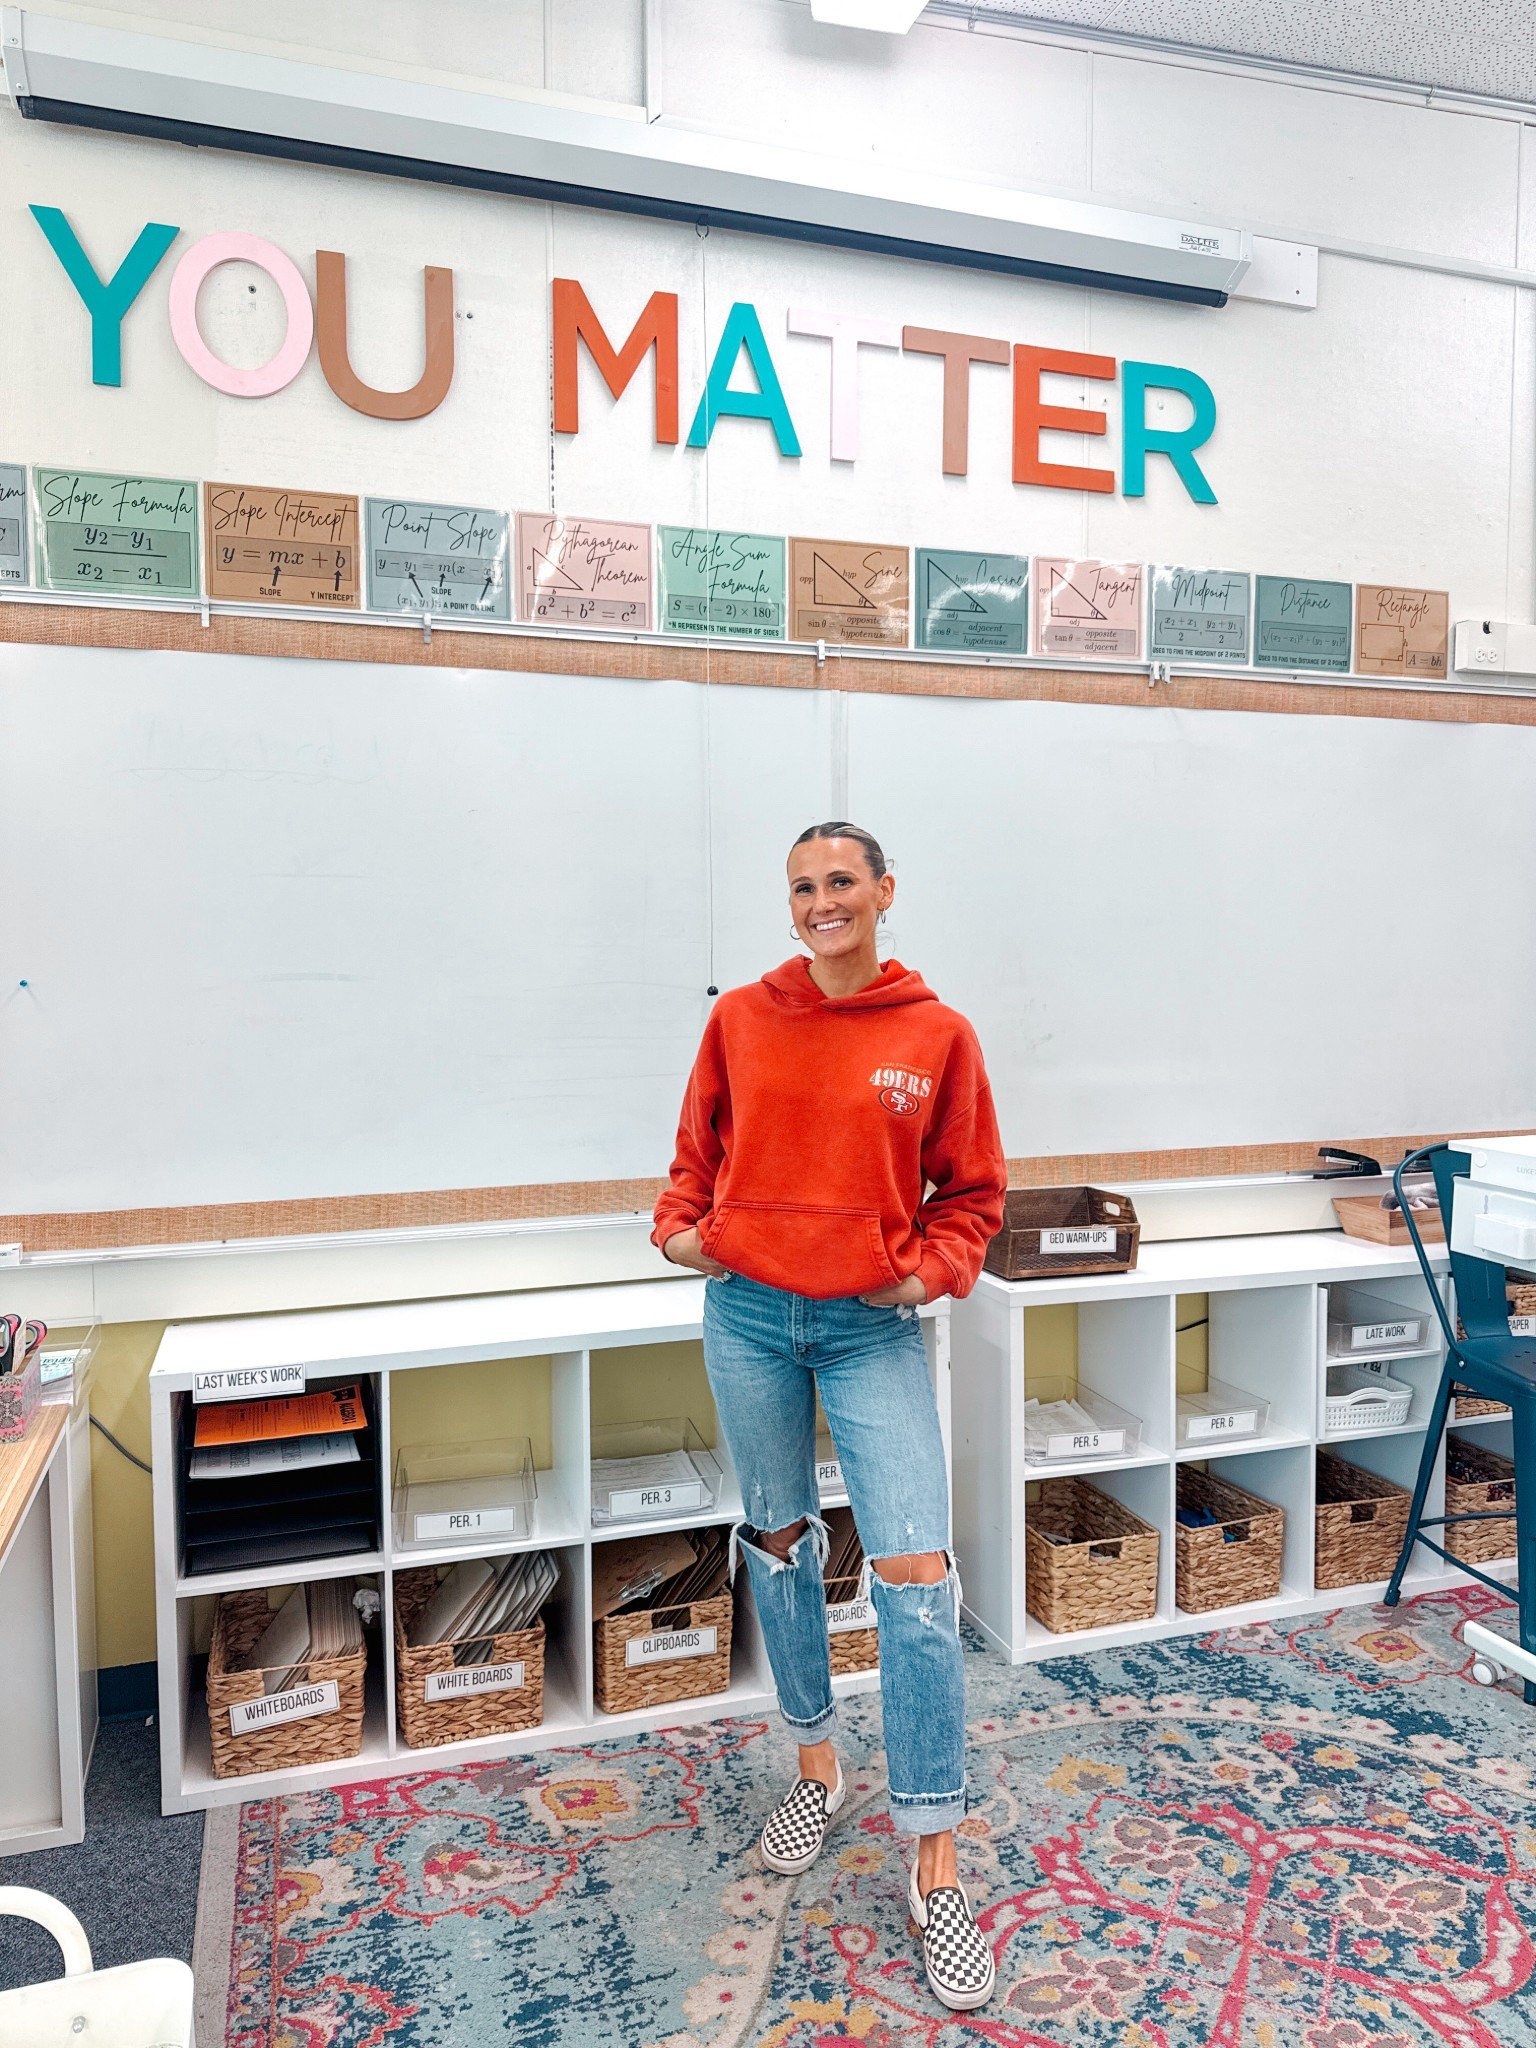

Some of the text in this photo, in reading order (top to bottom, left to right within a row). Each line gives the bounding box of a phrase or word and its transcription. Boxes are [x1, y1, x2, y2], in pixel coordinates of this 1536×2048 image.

[28, 204, 1219, 504] YOU MATTER
[44, 475, 193, 524] Slope Formula
[212, 490, 357, 542] Slope Intercept
[382, 504, 497, 555] Point Slope
[543, 520, 638, 564] Pythagorean
[672, 529, 770, 573] Angle Sum
[588, 553, 648, 592] Theorem
[842, 569, 857, 579] hyp
[863, 551, 902, 588] Sine
[976, 559, 1023, 594] Cosine
[431, 586, 452, 596] SLOPE
[707, 564, 769, 601] Formula
[1089, 565, 1141, 608] Tangent
[259, 587, 281, 597] SLOPE
[310, 591, 354, 602] Y INTERCEPT
[1172, 575, 1241, 611] Midpoint
[1281, 583, 1331, 618] Distance
[450, 602, 468, 610] POINT
[481, 605, 495, 613] LINE
[947, 612, 958, 620] adj
[1376, 588, 1430, 628] Rectangle
[678, 622, 715, 632] REPRESENTS
[716, 625, 727, 633] THE
[729, 626, 754, 635] NUMBER
[763, 629, 779, 637] SIDES
[968, 624, 1004, 633] adjacent
[1086, 630, 1117, 638] opposite
[963, 636, 1008, 646] hypotenuse
[1085, 642, 1118, 651] adjacent
[869, 1068, 932, 1098] 49ERS
[1516, 1166, 1536, 1176] LUKE
[1050, 1231, 1107, 1244] GEO WARM-UPS
[1366, 1325, 1406, 1339] LATE WORK
[197, 1367, 302, 1390] LAST WEEK'S WORK
[1210, 1416, 1234, 1429] PER. 6
[1073, 1435, 1099, 1448] PER. 5
[819, 1466, 839, 1479] PER.
[641, 1490, 671, 1505] PER. 3
[450, 1515, 481, 1528] PER. 1
[642, 1633, 700, 1654] CLIPBOARDS
[437, 1667, 513, 1690] WHITE BOARDS
[245, 1689, 325, 1721] WHITEBOARDS
